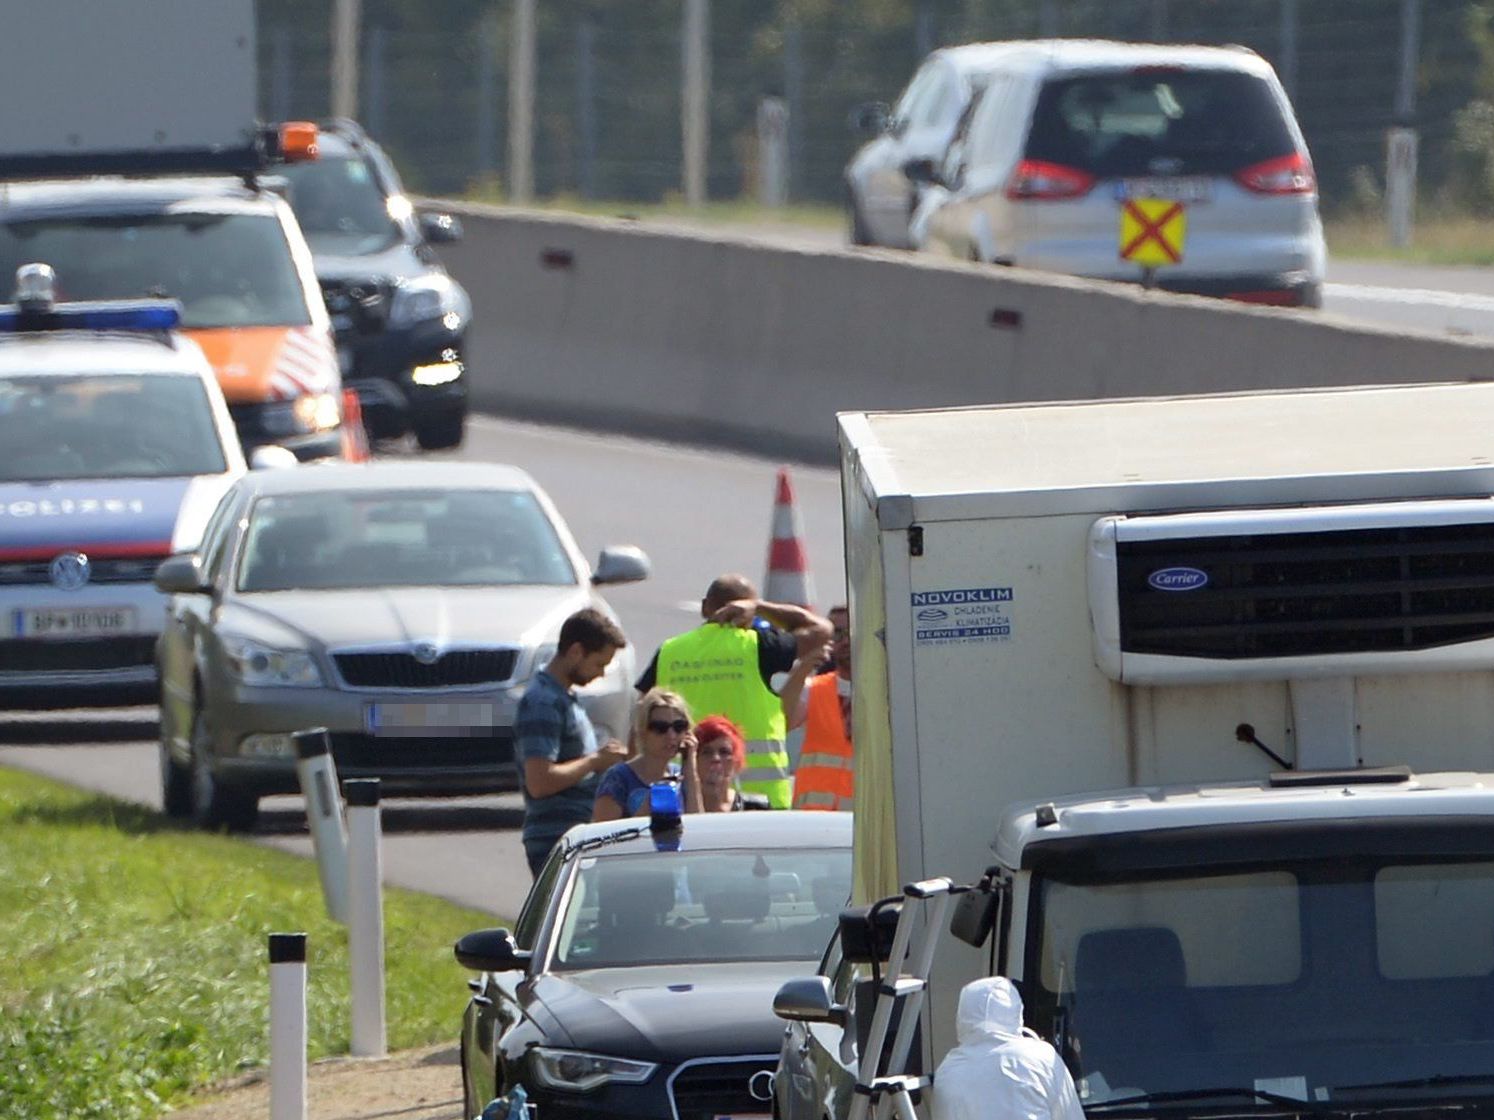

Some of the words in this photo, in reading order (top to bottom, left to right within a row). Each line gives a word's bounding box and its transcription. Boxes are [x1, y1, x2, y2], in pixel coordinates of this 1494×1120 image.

[1156, 572, 1199, 584] Carrier
[914, 589, 1010, 605] NOVOKLIM
[954, 604, 1001, 616] CHLADENIE
[918, 629, 960, 639] SERVIS
[964, 627, 979, 637] 24
